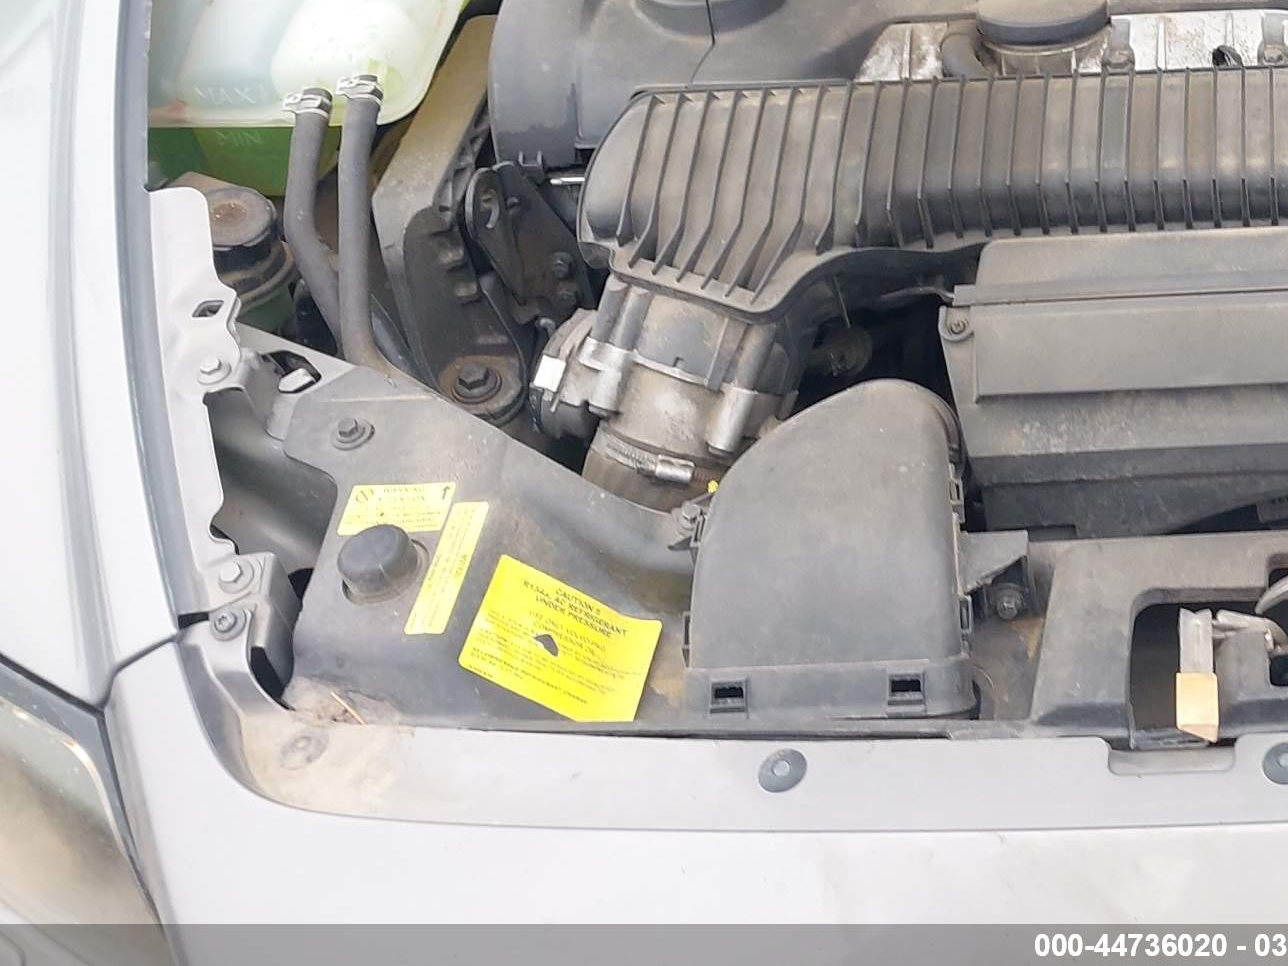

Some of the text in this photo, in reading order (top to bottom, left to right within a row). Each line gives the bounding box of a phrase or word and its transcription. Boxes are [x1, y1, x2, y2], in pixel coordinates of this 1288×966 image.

[535, 595, 611, 638] UNDER PRESSURE
[555, 588, 594, 613] CAUTION
[568, 603, 629, 637] REFRIGERANT
